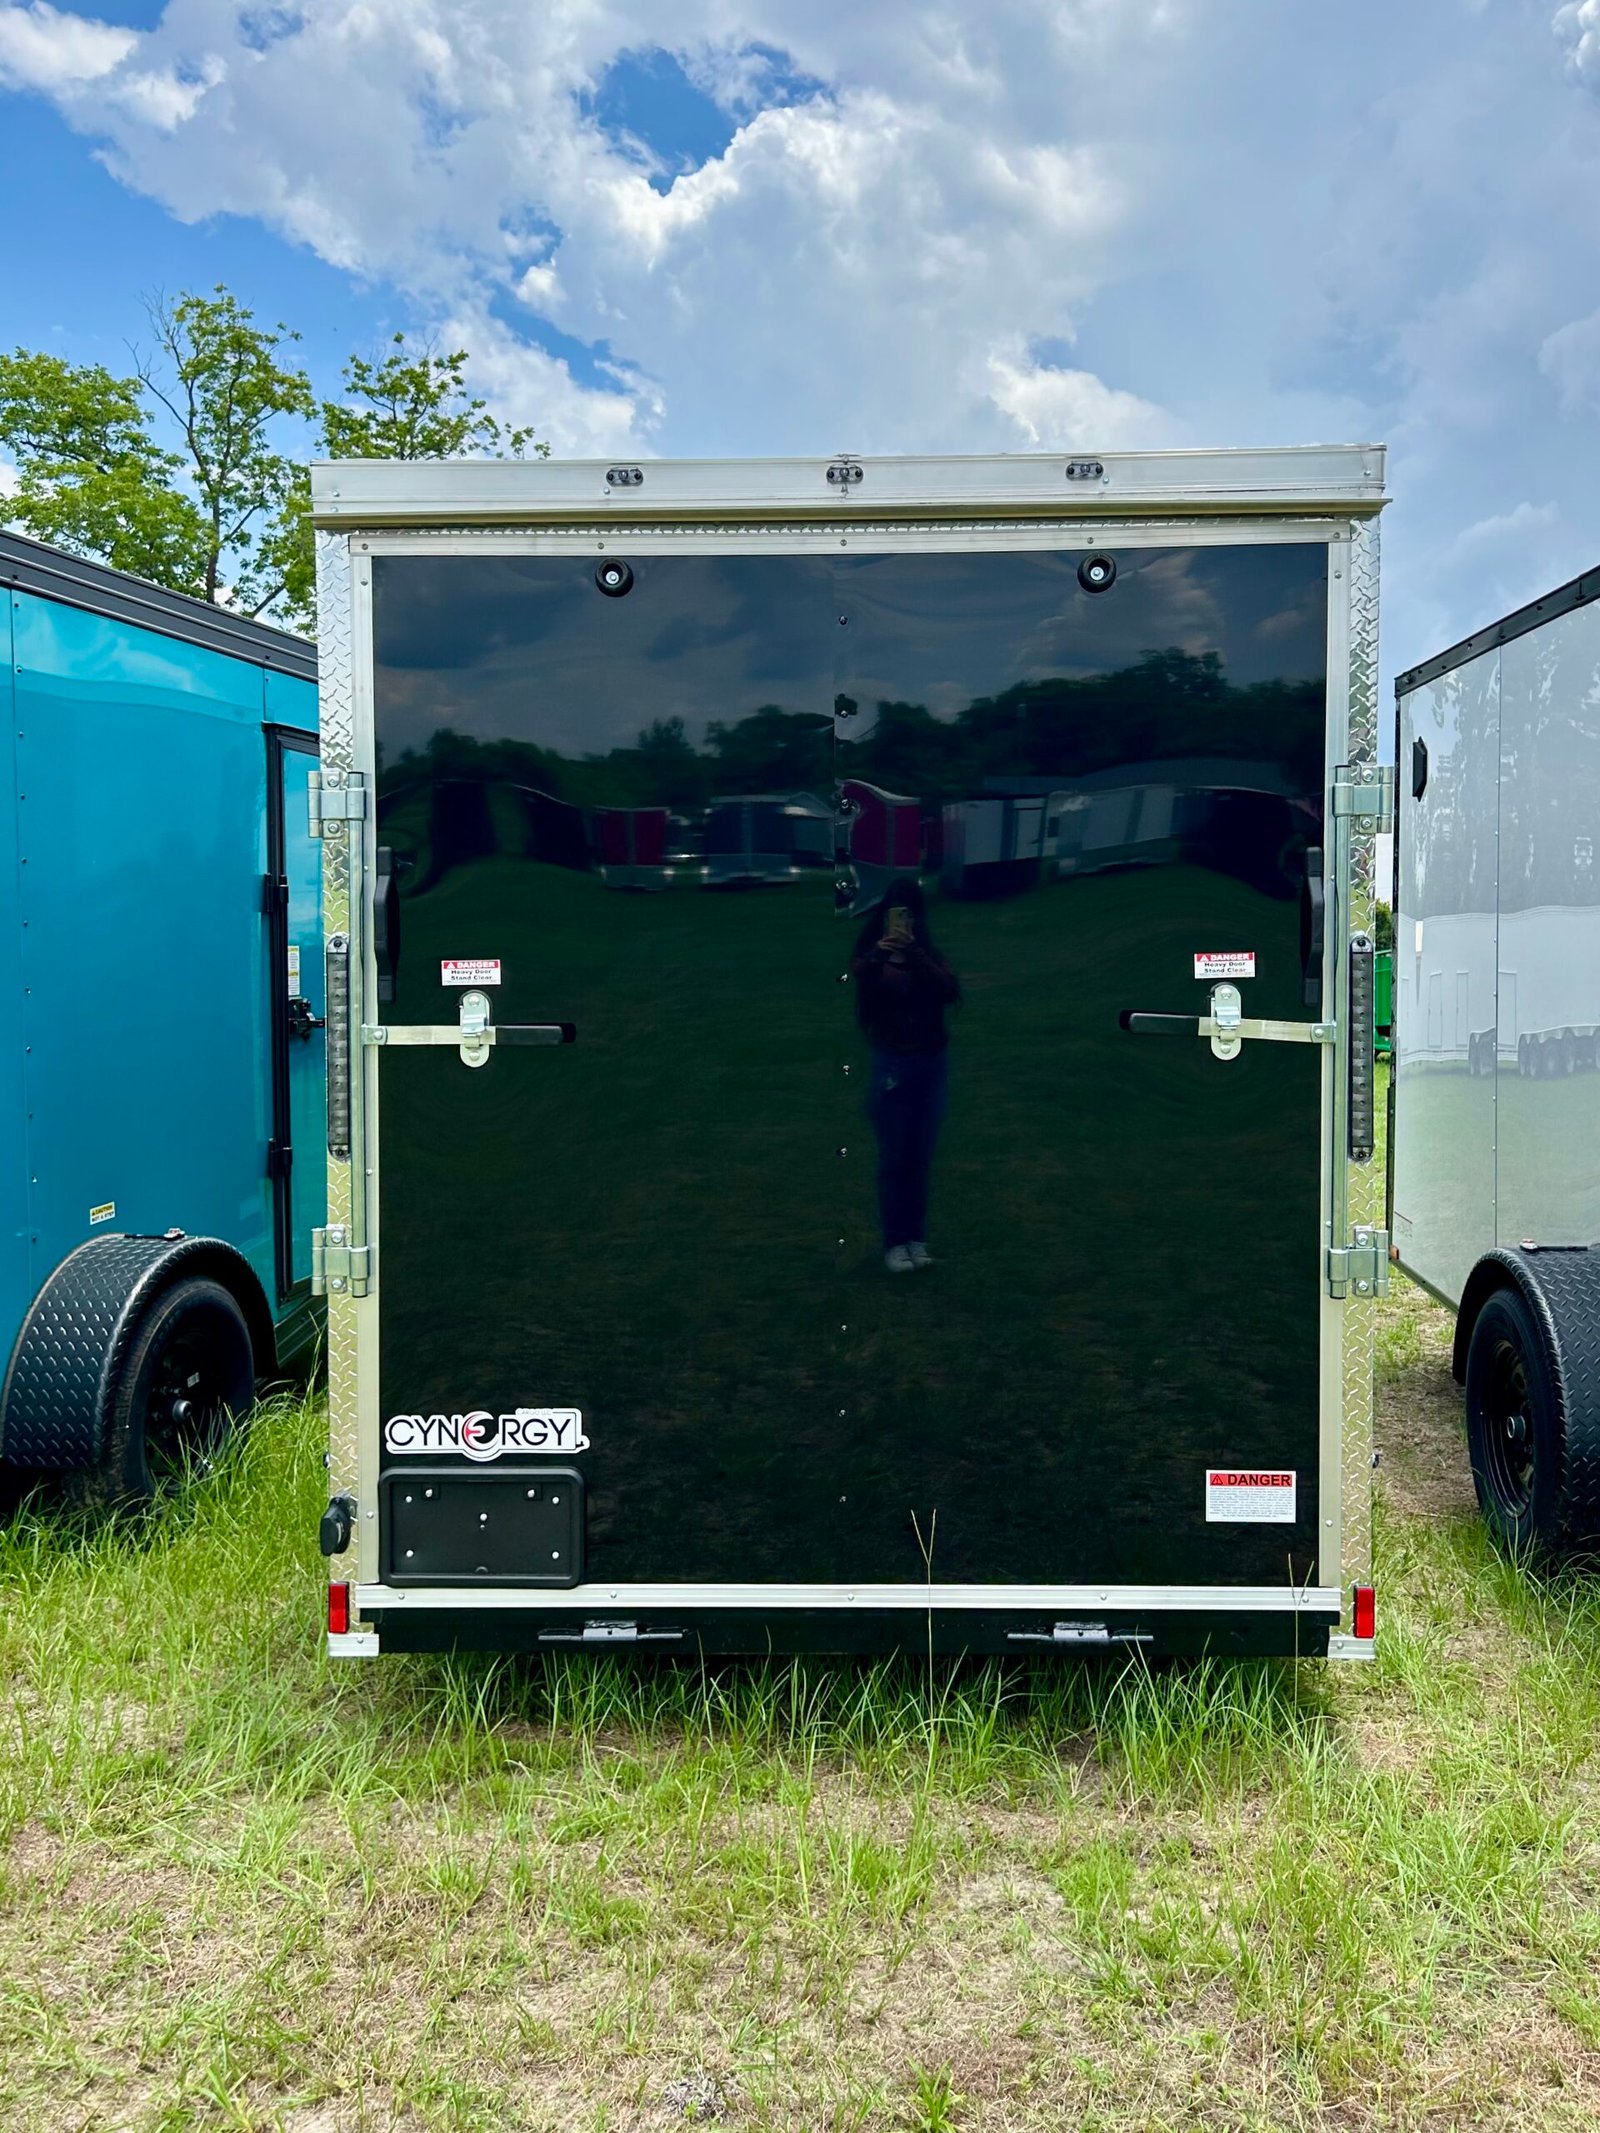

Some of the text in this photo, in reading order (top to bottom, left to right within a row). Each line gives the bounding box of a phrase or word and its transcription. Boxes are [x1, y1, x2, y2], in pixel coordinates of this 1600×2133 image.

[1210, 953, 1250, 961] DANGER
[456, 960, 495, 968] DANGER
[388, 1411, 572, 1451] CYNERGY
[1227, 1474, 1291, 1486] DANGER
